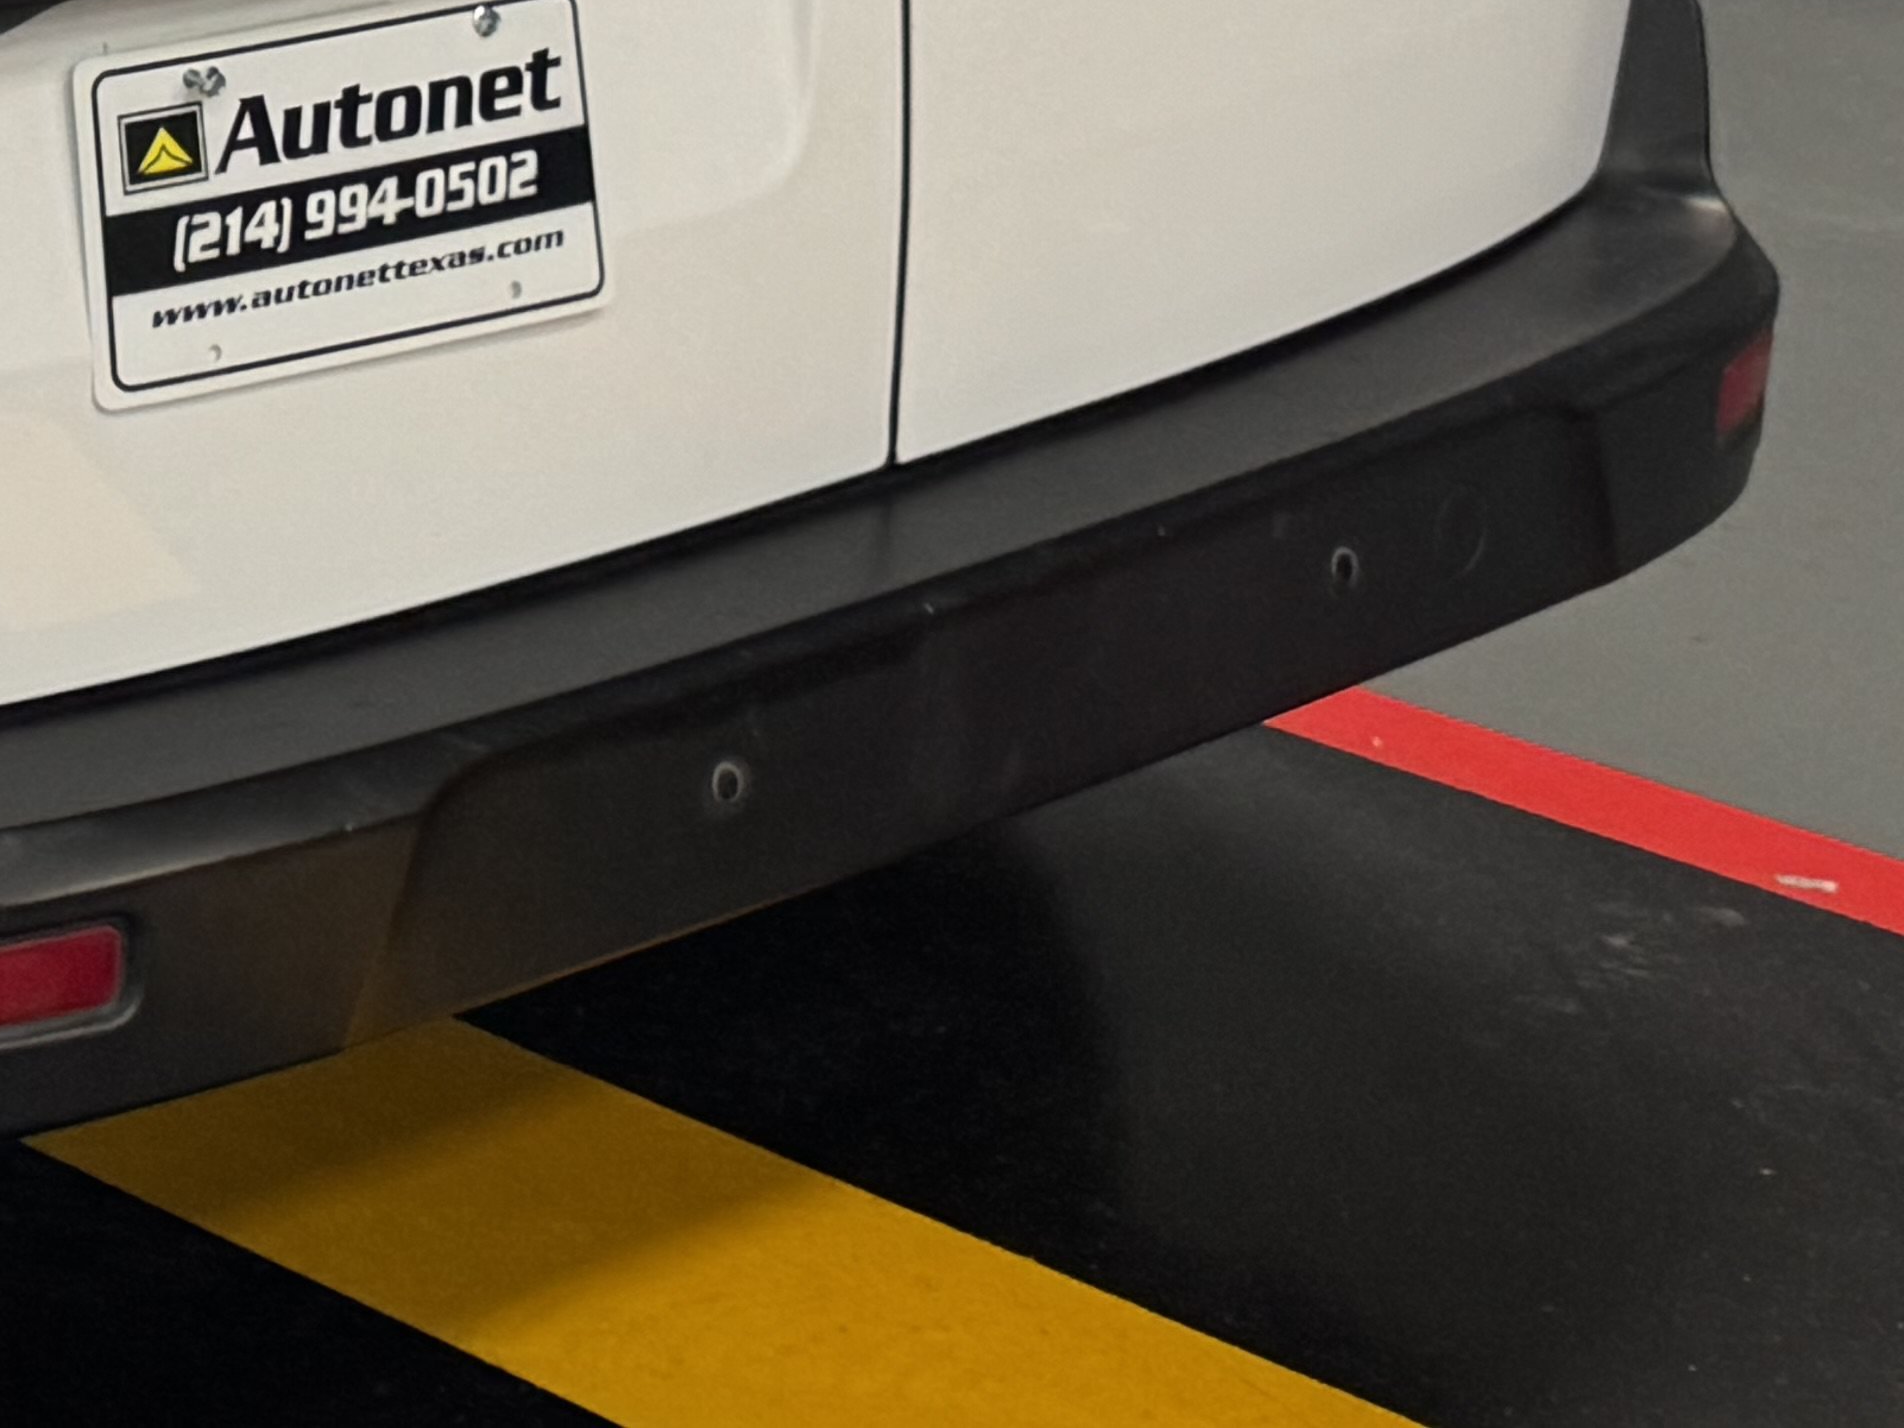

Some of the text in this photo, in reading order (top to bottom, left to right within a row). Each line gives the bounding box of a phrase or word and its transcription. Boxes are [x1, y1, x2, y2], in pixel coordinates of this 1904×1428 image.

[216, 48, 561, 174] Autonet
[174, 149, 538, 272] (214) 994-0502
[152, 229, 564, 327] www.autonettexas.com
